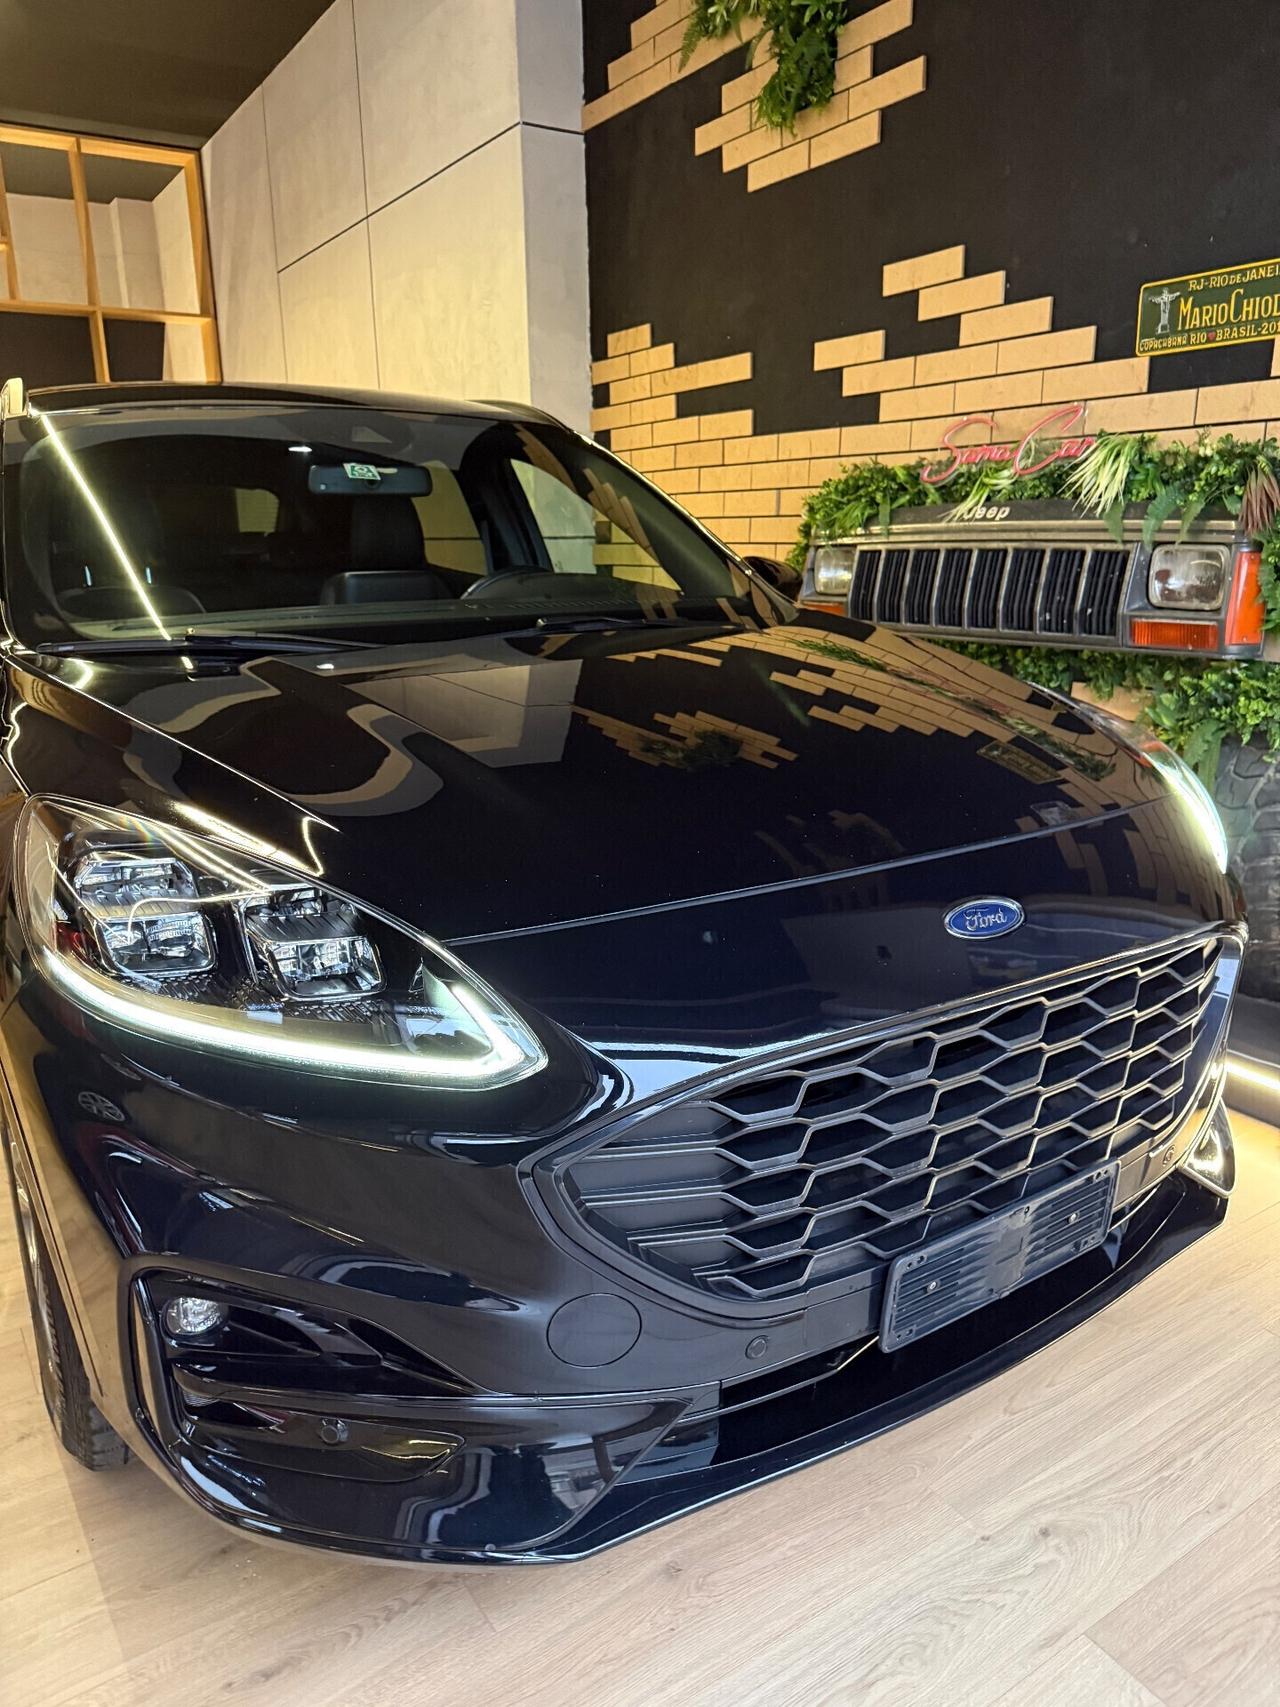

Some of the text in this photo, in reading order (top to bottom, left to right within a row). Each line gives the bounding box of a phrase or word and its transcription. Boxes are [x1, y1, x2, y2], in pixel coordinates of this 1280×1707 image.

[1242, 264, 1280, 282] JANEI
[1139, 336, 1187, 351] COPACABANA
[1190, 332, 1207, 345] RIO
[963, 506, 1011, 521] Jeep
[963, 907, 1007, 931] Ford
